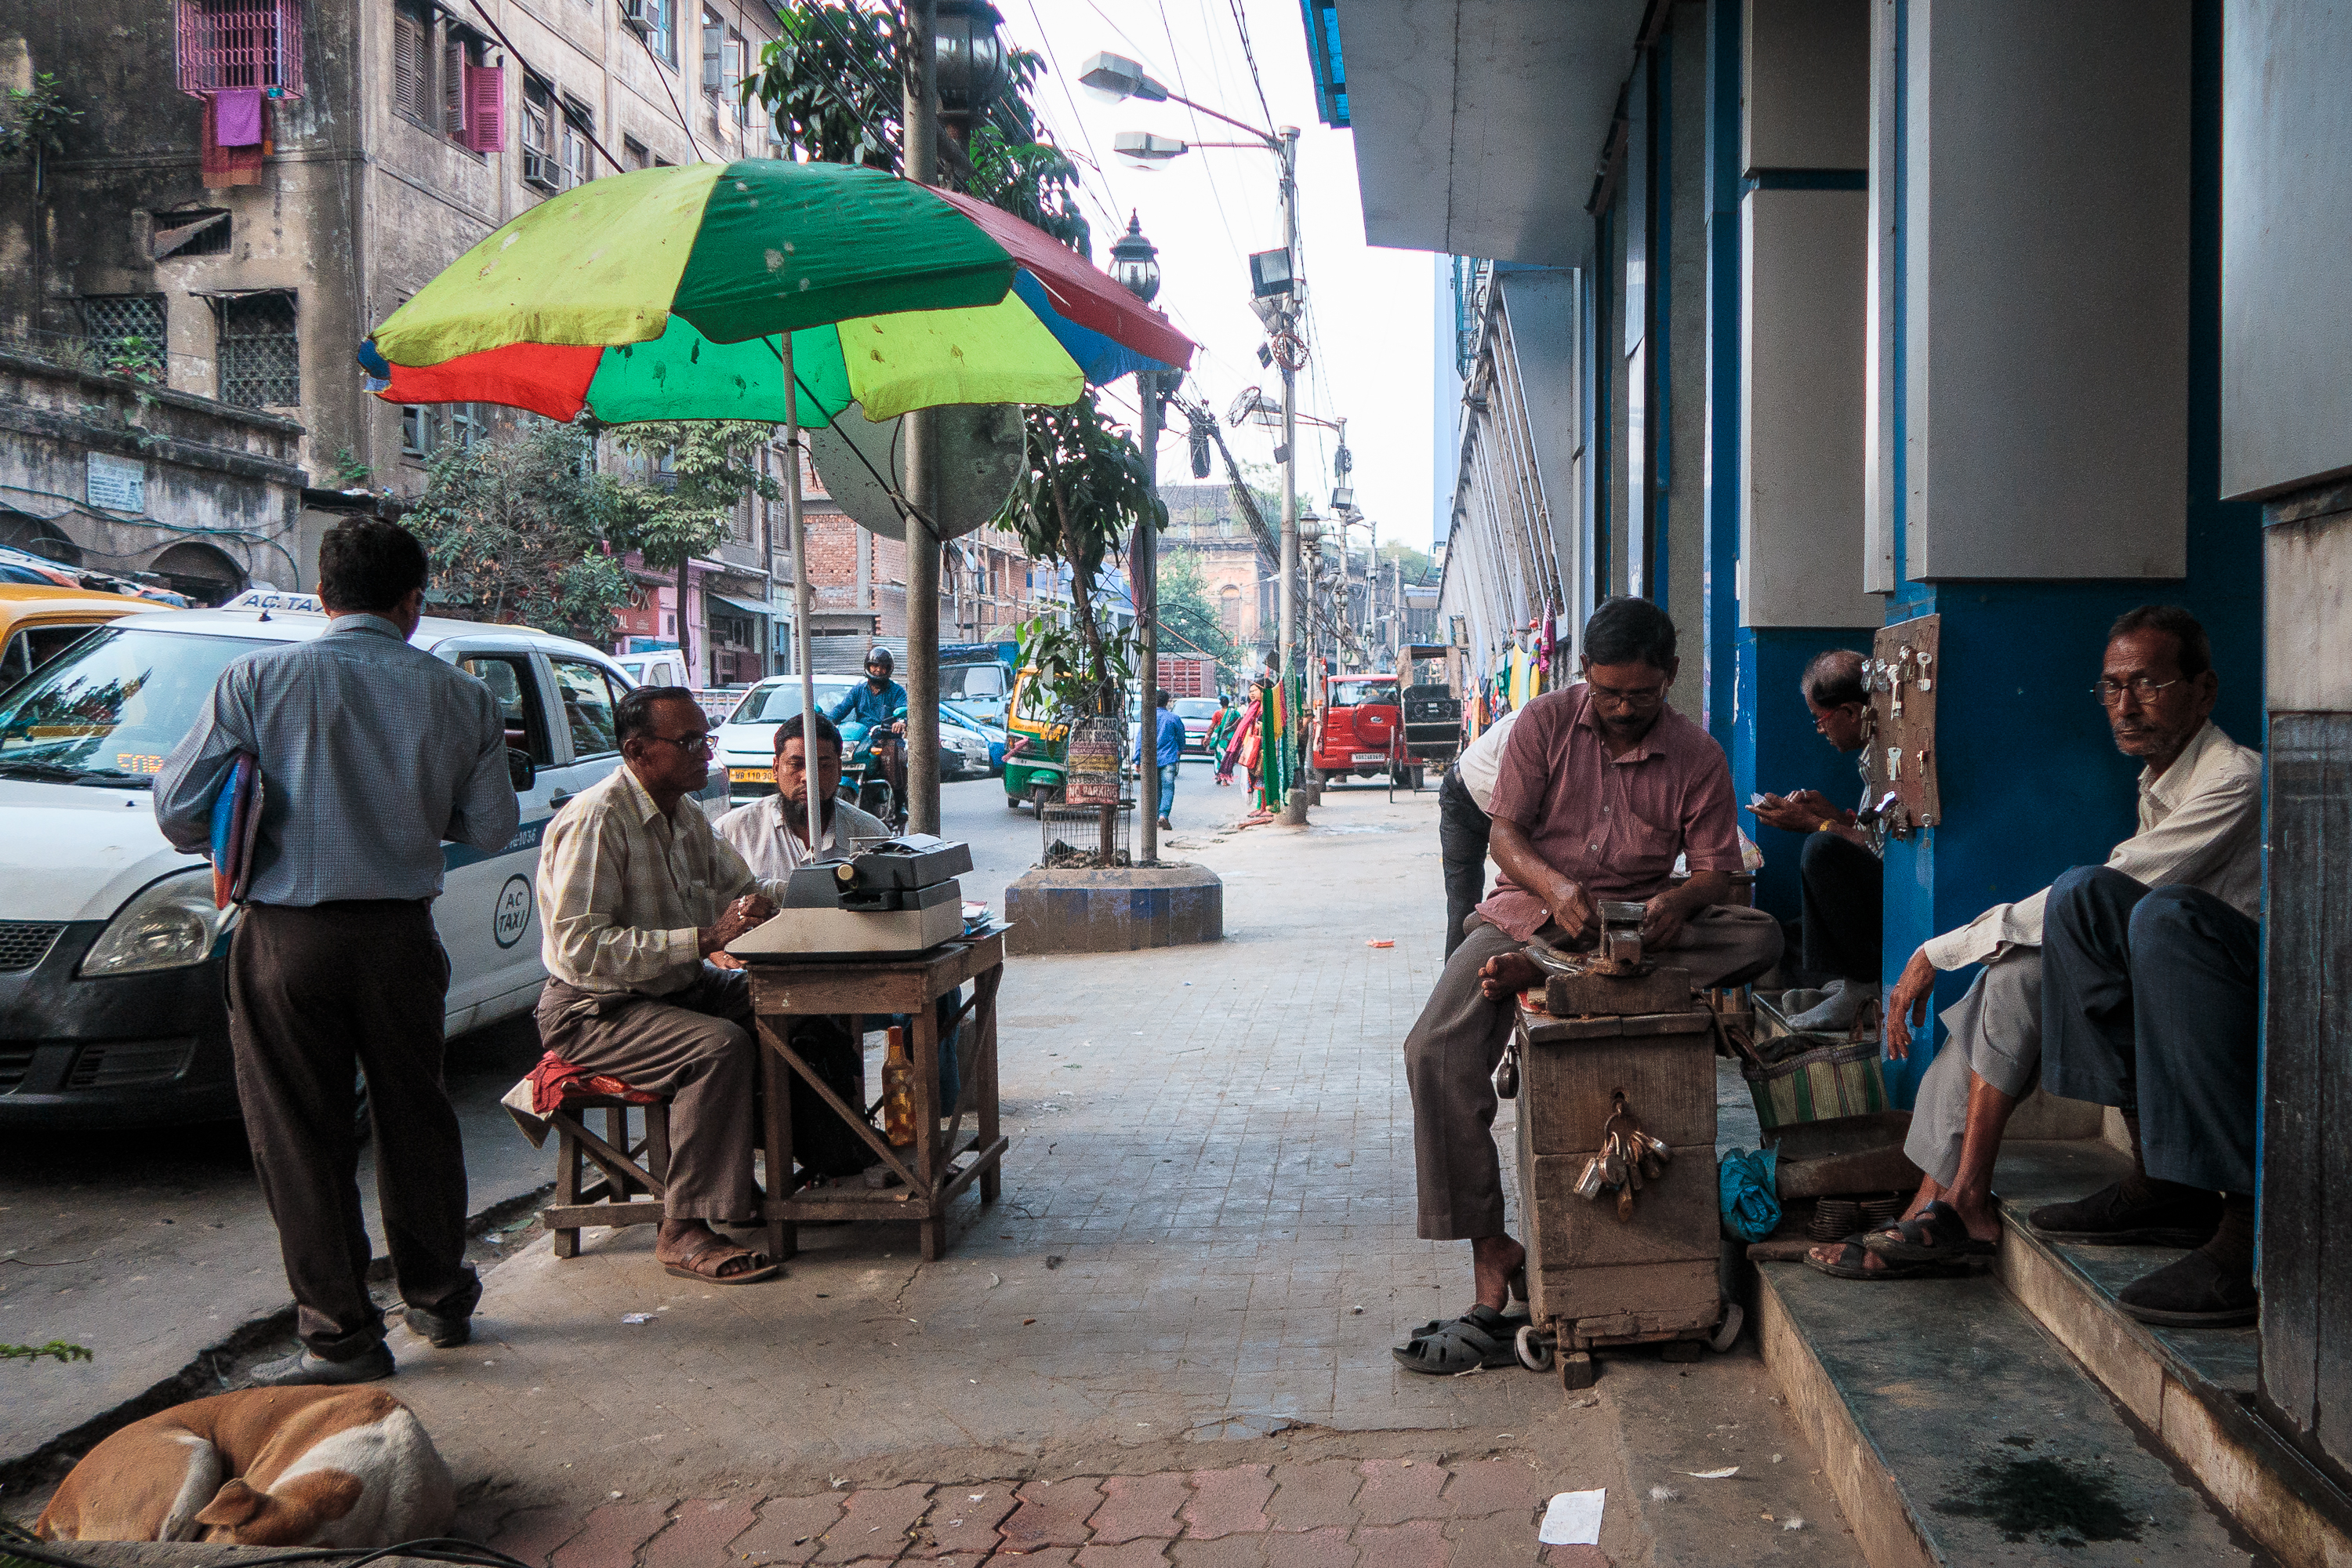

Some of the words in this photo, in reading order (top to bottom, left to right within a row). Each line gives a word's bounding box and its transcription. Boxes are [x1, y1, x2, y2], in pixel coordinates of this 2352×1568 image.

[615, 614, 629, 629] AL
[1071, 731, 1092, 742] PUBLIC
[1069, 786, 1080, 796] NO
[1083, 786, 1118, 797] PARKING
[506, 891, 524, 909] AC
[499, 909, 525, 933] TAXI
